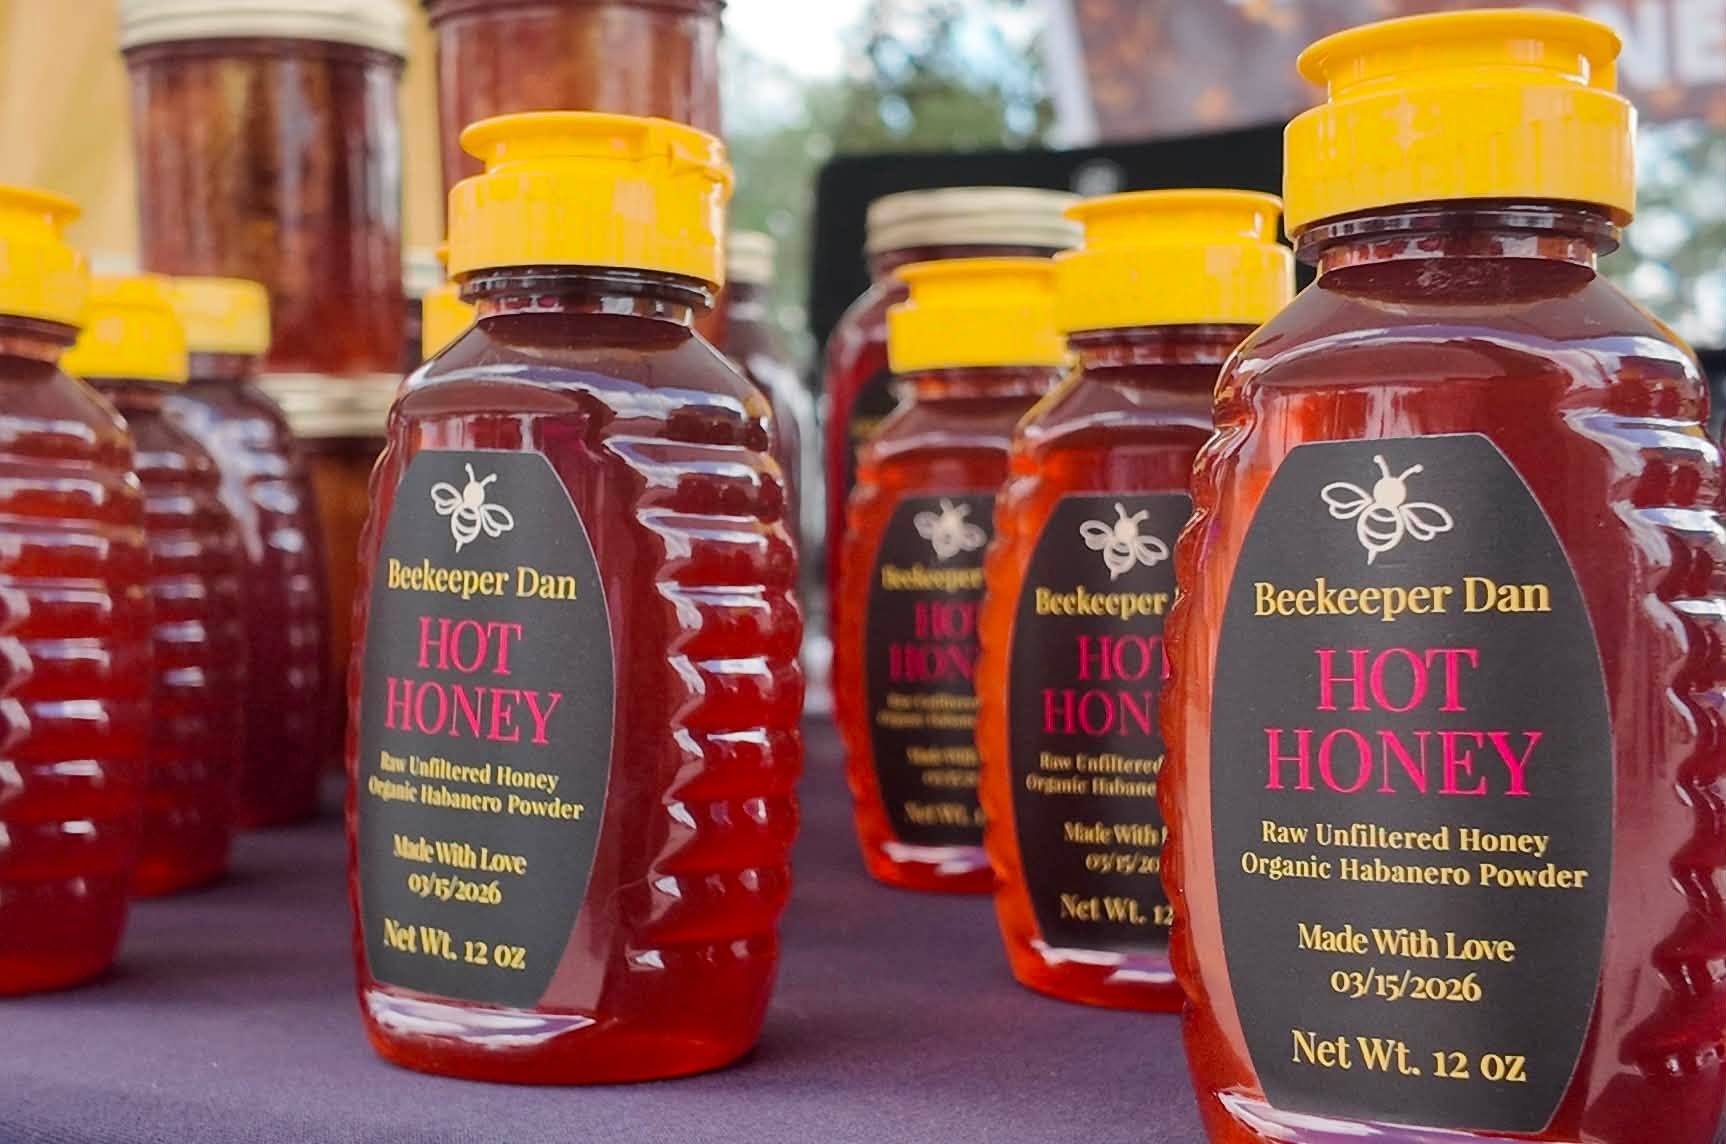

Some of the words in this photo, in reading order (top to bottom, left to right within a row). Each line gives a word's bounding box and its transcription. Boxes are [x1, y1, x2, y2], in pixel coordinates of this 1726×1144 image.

[388, 558, 509, 600] Beekeeper
[516, 566, 577, 600] Dan
[1254, 577, 1453, 621] Beekeeper
[1463, 576, 1552, 613] Dan
[914, 601, 976, 639] HO
[1035, 584, 1168, 621] Beekeeper
[417, 615, 523, 675] HOT
[889, 642, 975, 682] HON
[1315, 647, 1479, 713] HOT
[384, 677, 562, 745] HONEY
[1042, 687, 1155, 737] HON
[380, 751, 407, 772] Raw
[409, 755, 491, 786] Unfiltered
[497, 765, 560, 794] Honey
[1039, 752, 1072, 771] Raw
[1264, 728, 1543, 796] HONEY
[368, 775, 417, 802] Organic
[421, 783, 501, 813] Habanero
[508, 794, 584, 820] Powder
[1025, 773, 1088, 795] Organic
[1092, 776, 1157, 797] Habane
[1064, 821, 1113, 845] Made
[1113, 823, 1160, 847] With
[1262, 820, 1308, 844] Raw
[1316, 823, 1449, 851] Unfiltered
[1459, 828, 1549, 857] Honey
[393, 833, 434, 863] Made
[435, 840, 477, 870] With
[481, 847, 527, 876] Love
[1085, 853, 1160, 875] 03/15/20
[1241, 852, 1331, 880] Organic
[1340, 858, 1470, 886] Habanero
[1479, 863, 1589, 889] Powder
[408, 872, 502, 904] 03/15/2026
[1060, 893, 1100, 921] Net
[1104, 897, 1147, 925] Wt.
[384, 918, 417, 952] Net
[421, 926, 457, 961] Wt.
[464, 941, 488, 966] 12
[1298, 923, 1368, 955] Made
[1372, 928, 1439, 959] With
[1445, 933, 1516, 962] Love
[1330, 967, 1482, 1002] 03/15/2026
[1291, 1030, 1351, 1070] Net
[1356, 1037, 1421, 1077] Wt.
[1433, 1050, 1470, 1079] 12
